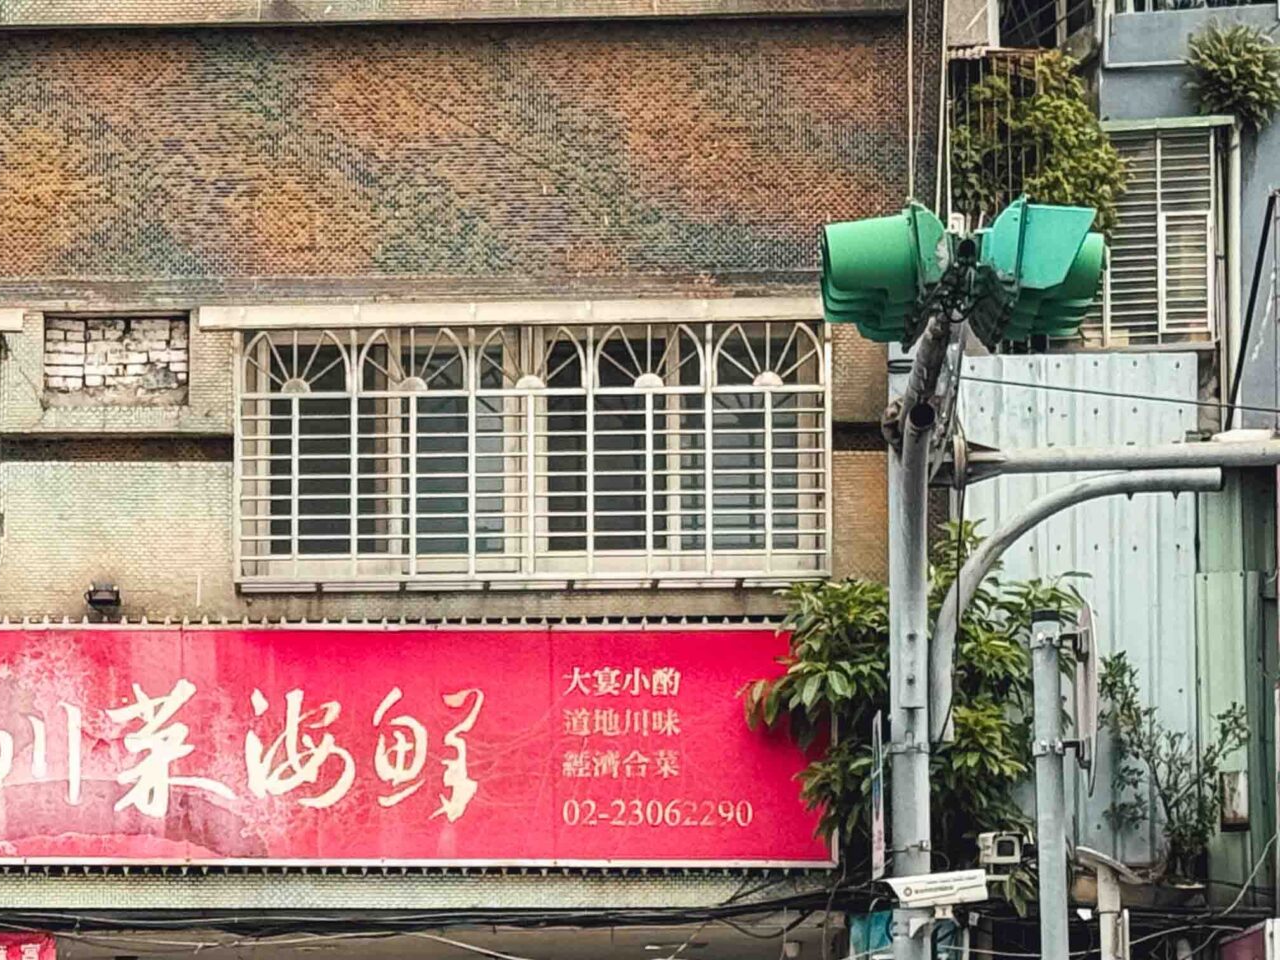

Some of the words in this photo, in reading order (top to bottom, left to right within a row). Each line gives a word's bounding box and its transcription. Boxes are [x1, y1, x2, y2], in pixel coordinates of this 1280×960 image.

[562, 667, 682, 696] 大宴小酌
[562, 708, 682, 737] 道地川味
[562, 750, 681, 779] 經濟合菜
[562, 799, 753, 827] 02-23062290
